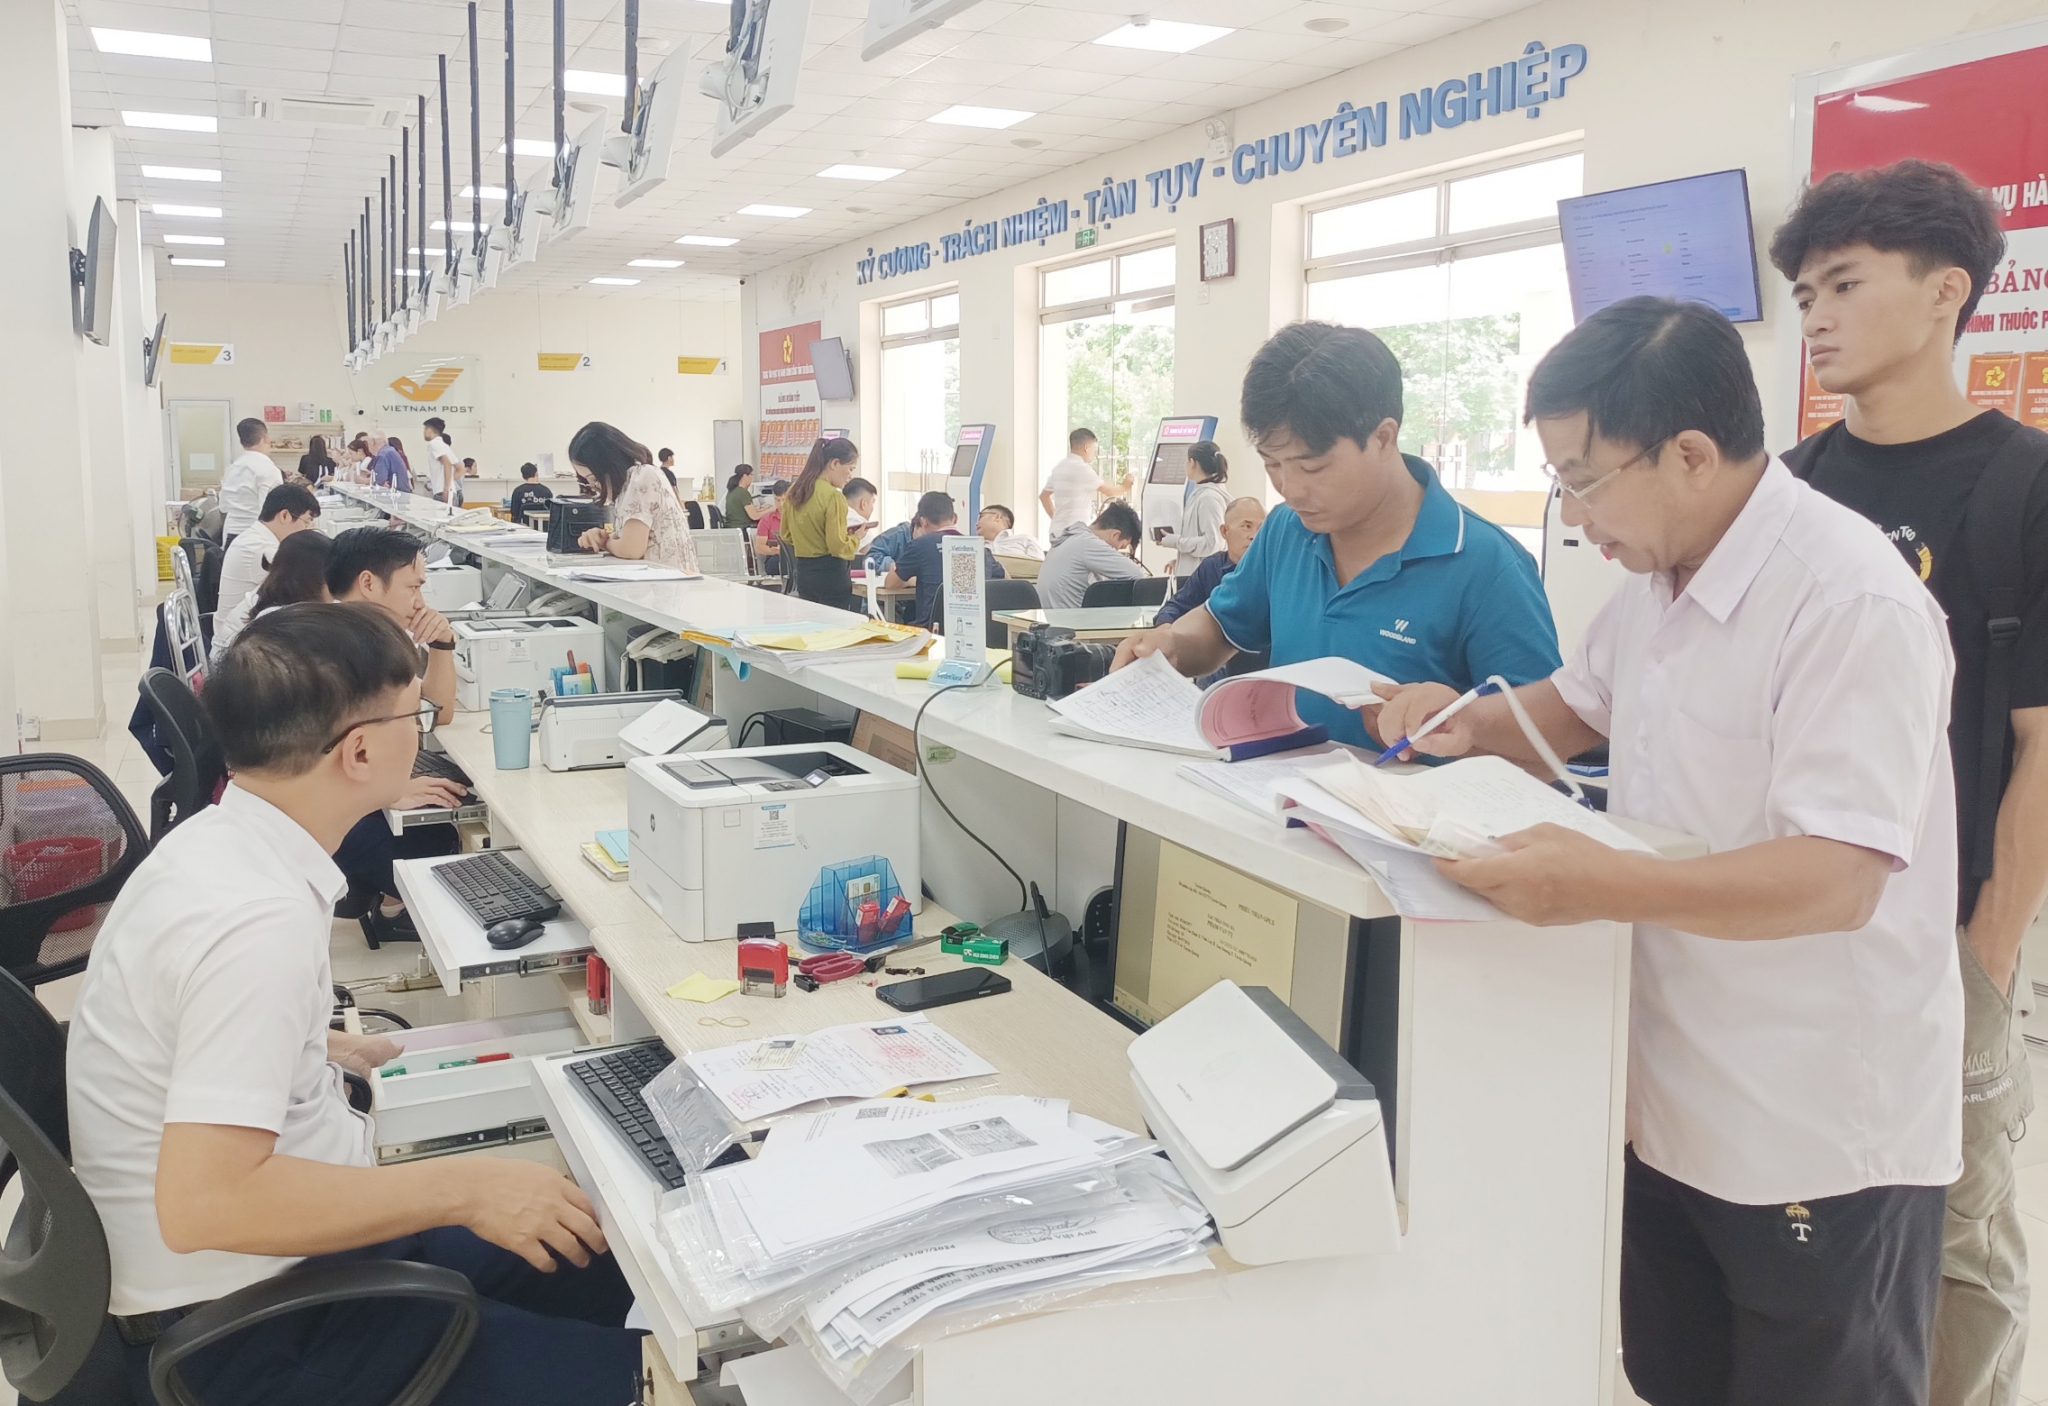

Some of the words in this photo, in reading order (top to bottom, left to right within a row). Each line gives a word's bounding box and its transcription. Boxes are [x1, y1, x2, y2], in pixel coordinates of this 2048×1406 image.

[857, 248, 876, 285] KỶ
[878, 242, 930, 279] CƯƠNG
[940, 219, 998, 263] TRÁCH
[1001, 197, 1068, 247] NHIỆM
[1084, 177, 1137, 230] TẬN
[1145, 157, 1205, 213] TỤY
[1232, 101, 1387, 185] CHUYÊN
[1399, 40, 1588, 140] NGHIỆP
[1999, 307, 2038, 334] THUỘC
[222, 350, 232, 362] 3
[582, 356, 591, 367] 2
[720, 361, 726, 371] 1
[1986, 1077, 2013, 1099] BRAND
[1077, 1229, 1097, 1237] Anh
[875, 1304, 901, 1323] NAM
